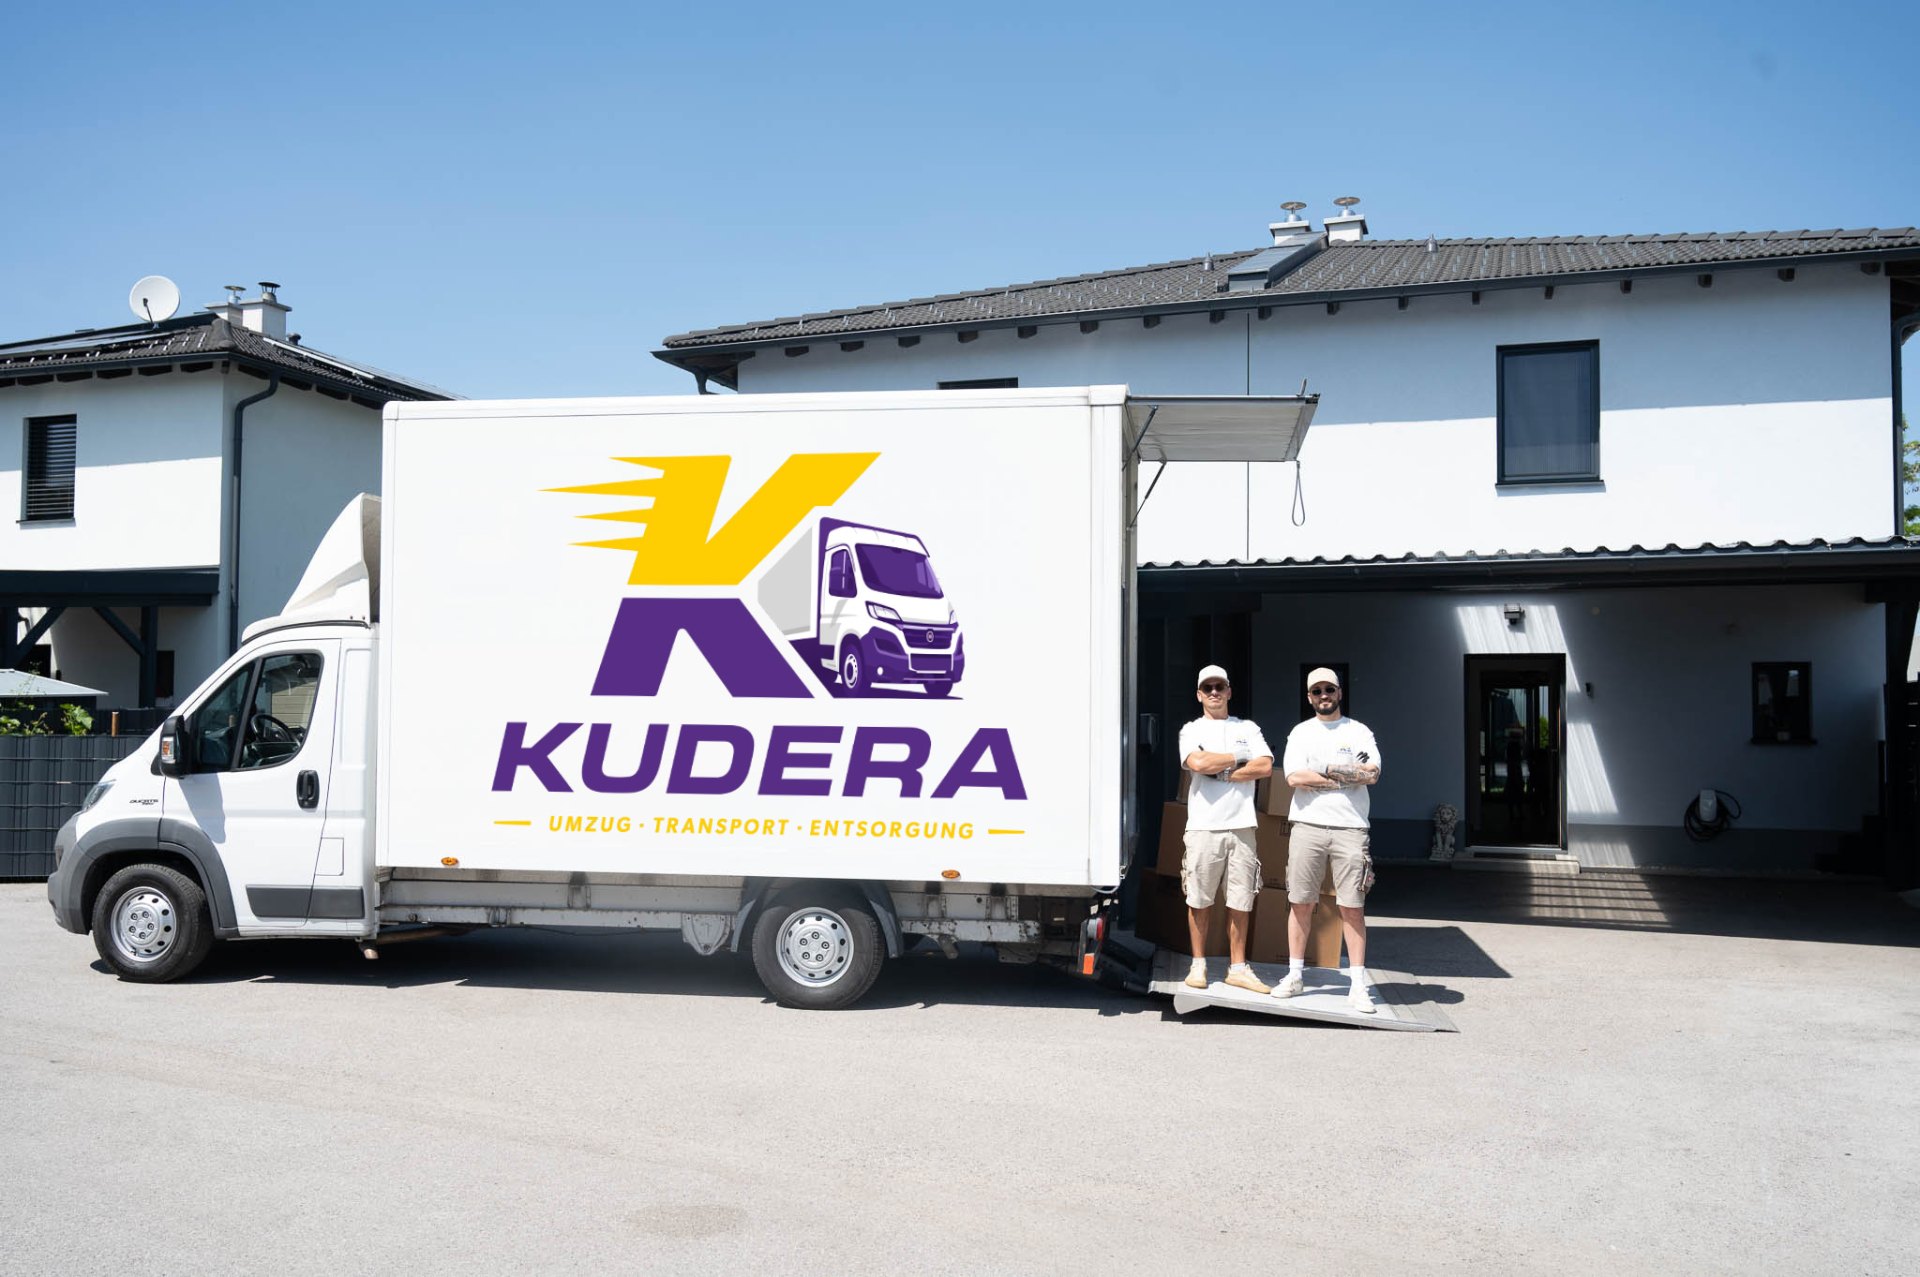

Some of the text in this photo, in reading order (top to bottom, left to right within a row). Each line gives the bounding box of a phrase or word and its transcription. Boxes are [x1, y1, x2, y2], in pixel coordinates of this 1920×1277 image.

[491, 721, 1028, 801] KUDERA
[548, 815, 975, 841] UMZUG TRANSPORT ENTSORGUNG
